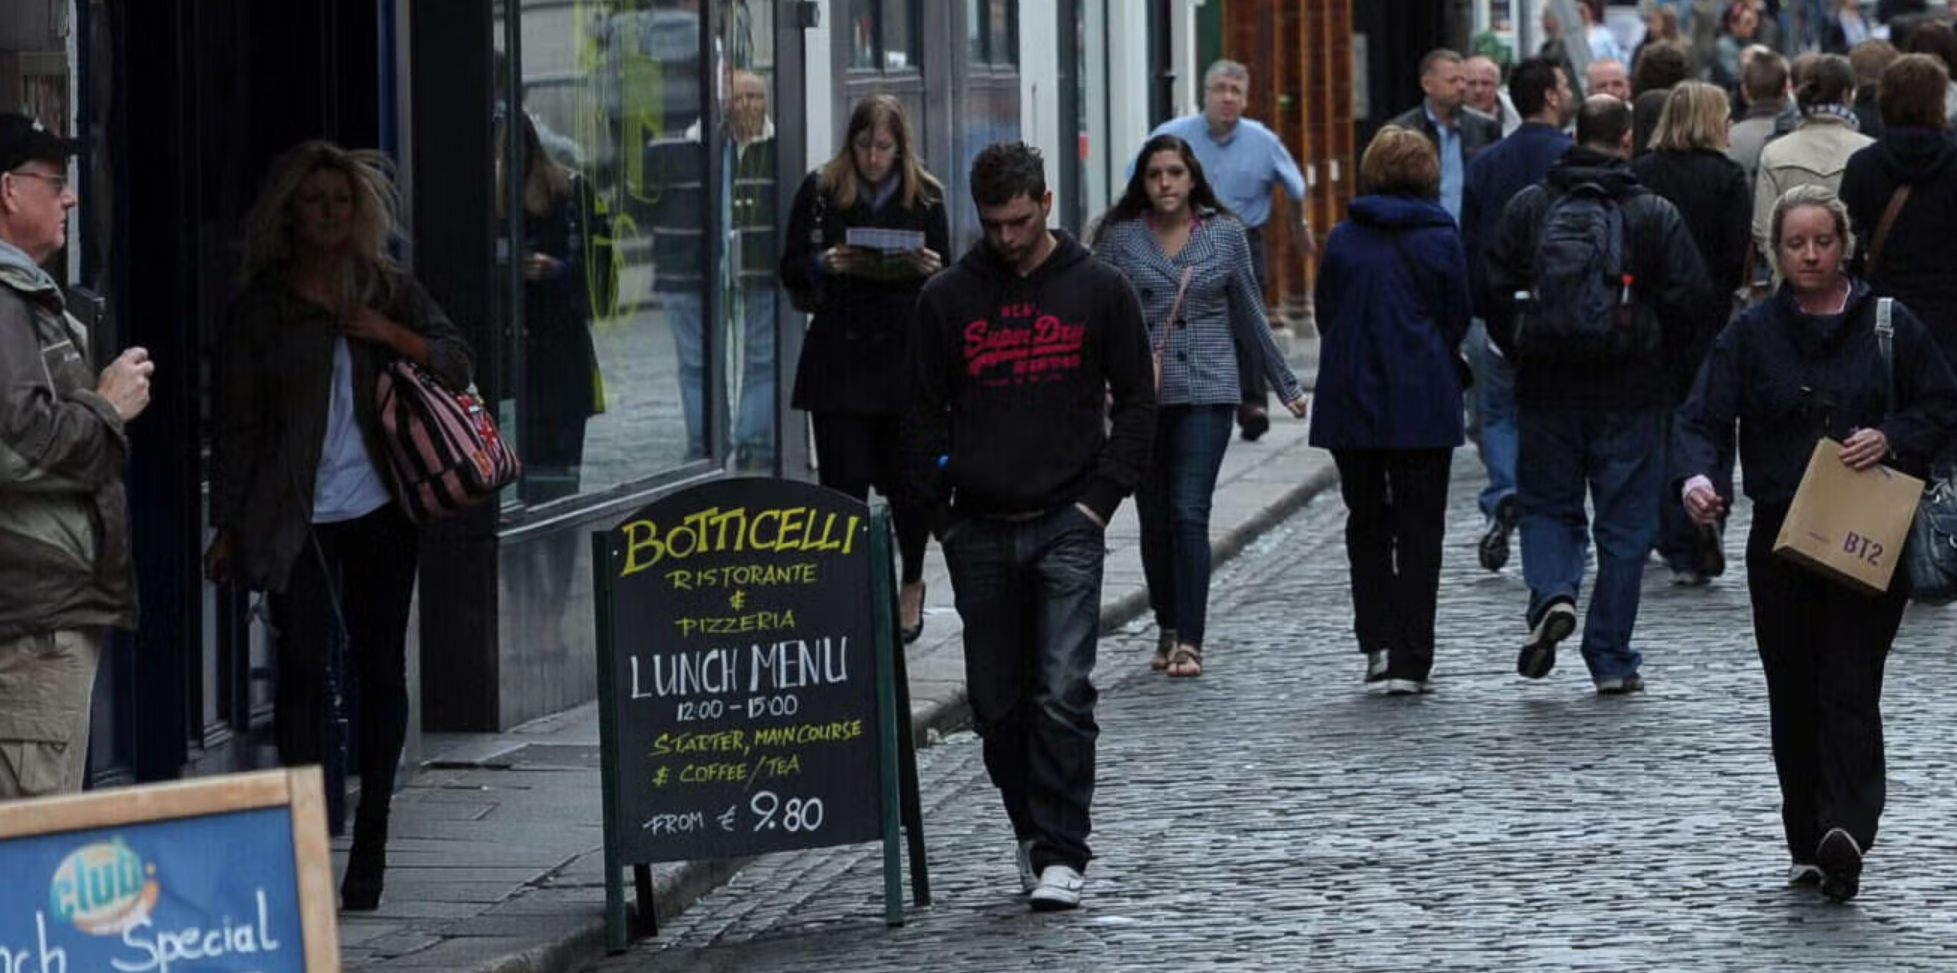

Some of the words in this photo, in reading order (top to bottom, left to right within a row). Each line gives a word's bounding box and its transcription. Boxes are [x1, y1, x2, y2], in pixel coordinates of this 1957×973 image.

[620, 507, 860, 577] BOTTICELLI
[1843, 530, 1884, 566] BT2
[664, 564, 817, 590] RISTORANTE
[674, 609, 795, 637] PIZZERIA
[631, 648, 738, 699] LUNCH
[750, 636, 848, 693] MENU
[643, 812, 704, 836] FROM
[751, 791, 823, 831] 9.80
[52, 837, 143, 922] club
[111, 888, 279, 973] Special
